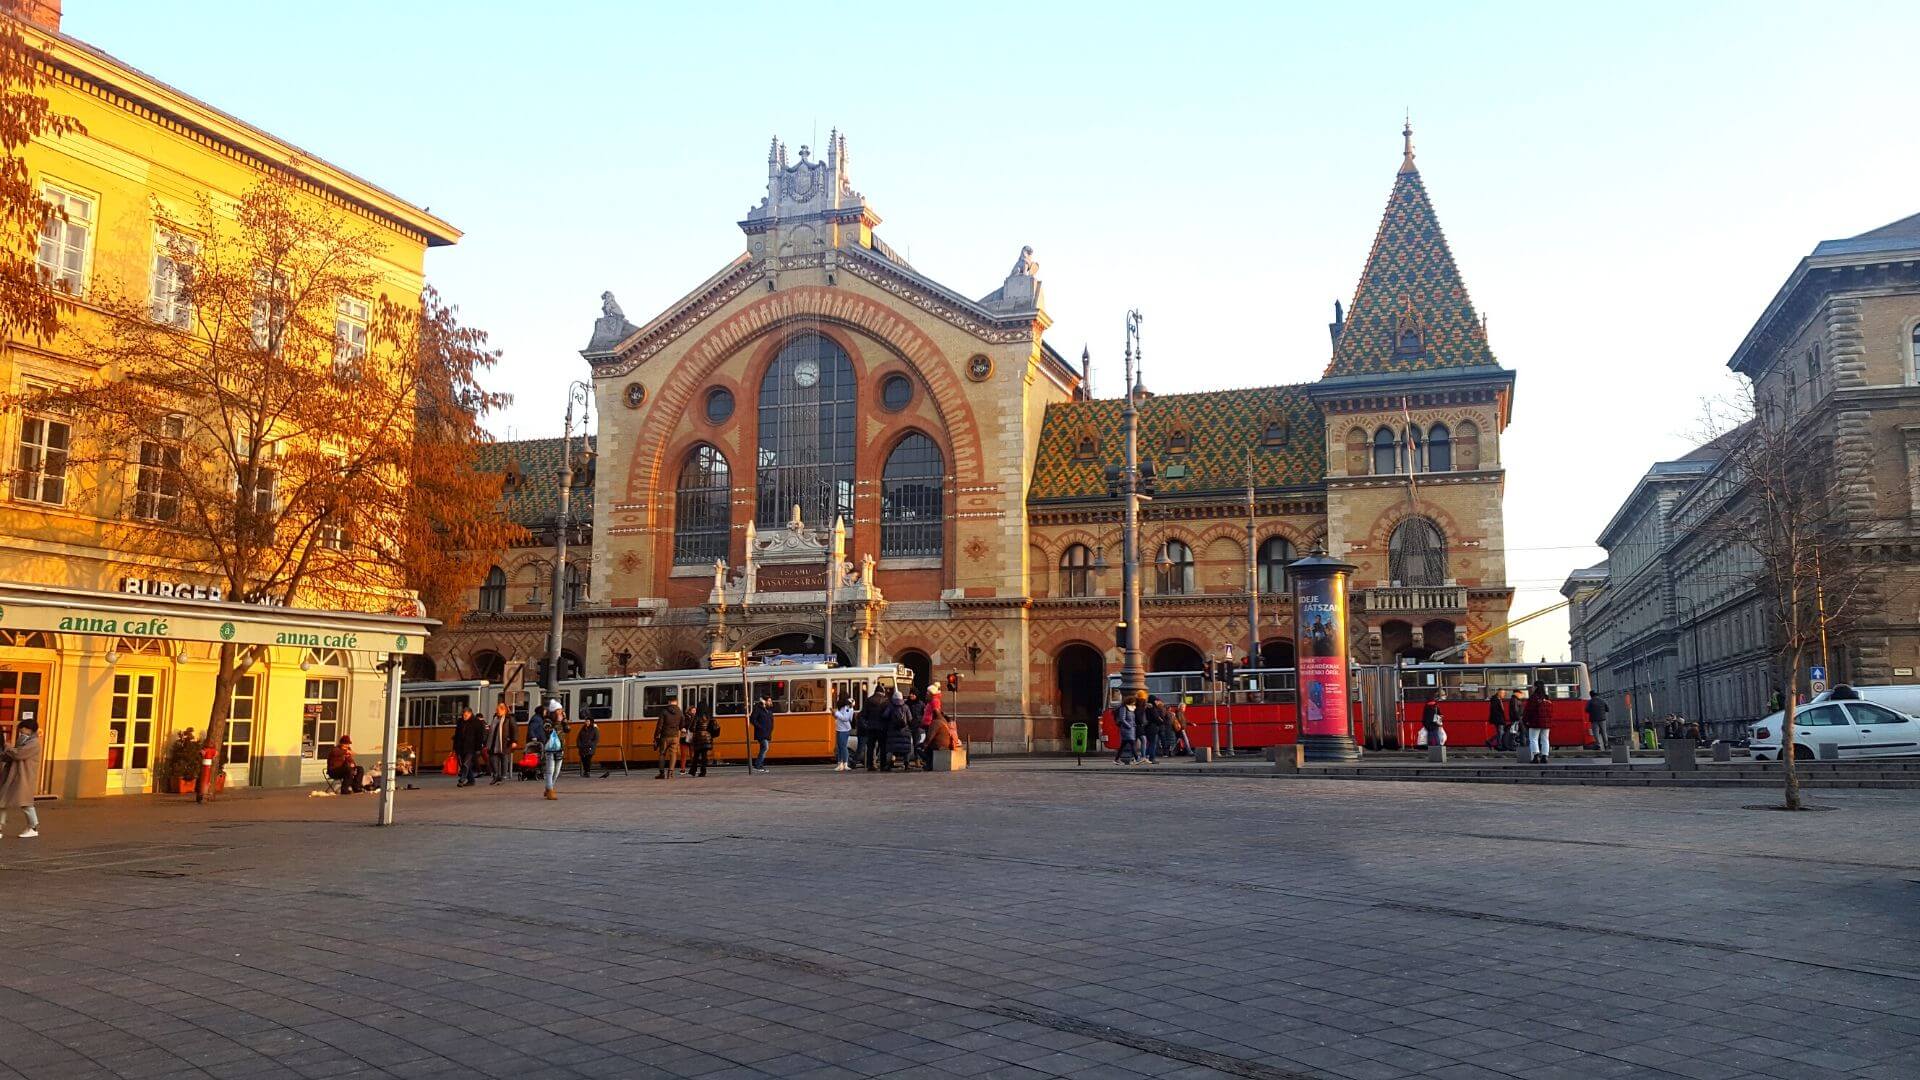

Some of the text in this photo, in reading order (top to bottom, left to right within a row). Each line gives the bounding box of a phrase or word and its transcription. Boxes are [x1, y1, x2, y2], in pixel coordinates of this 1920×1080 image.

[125, 577, 222, 601] BURGER
[59, 616, 169, 636] anna café
[276, 632, 358, 649] anna café
